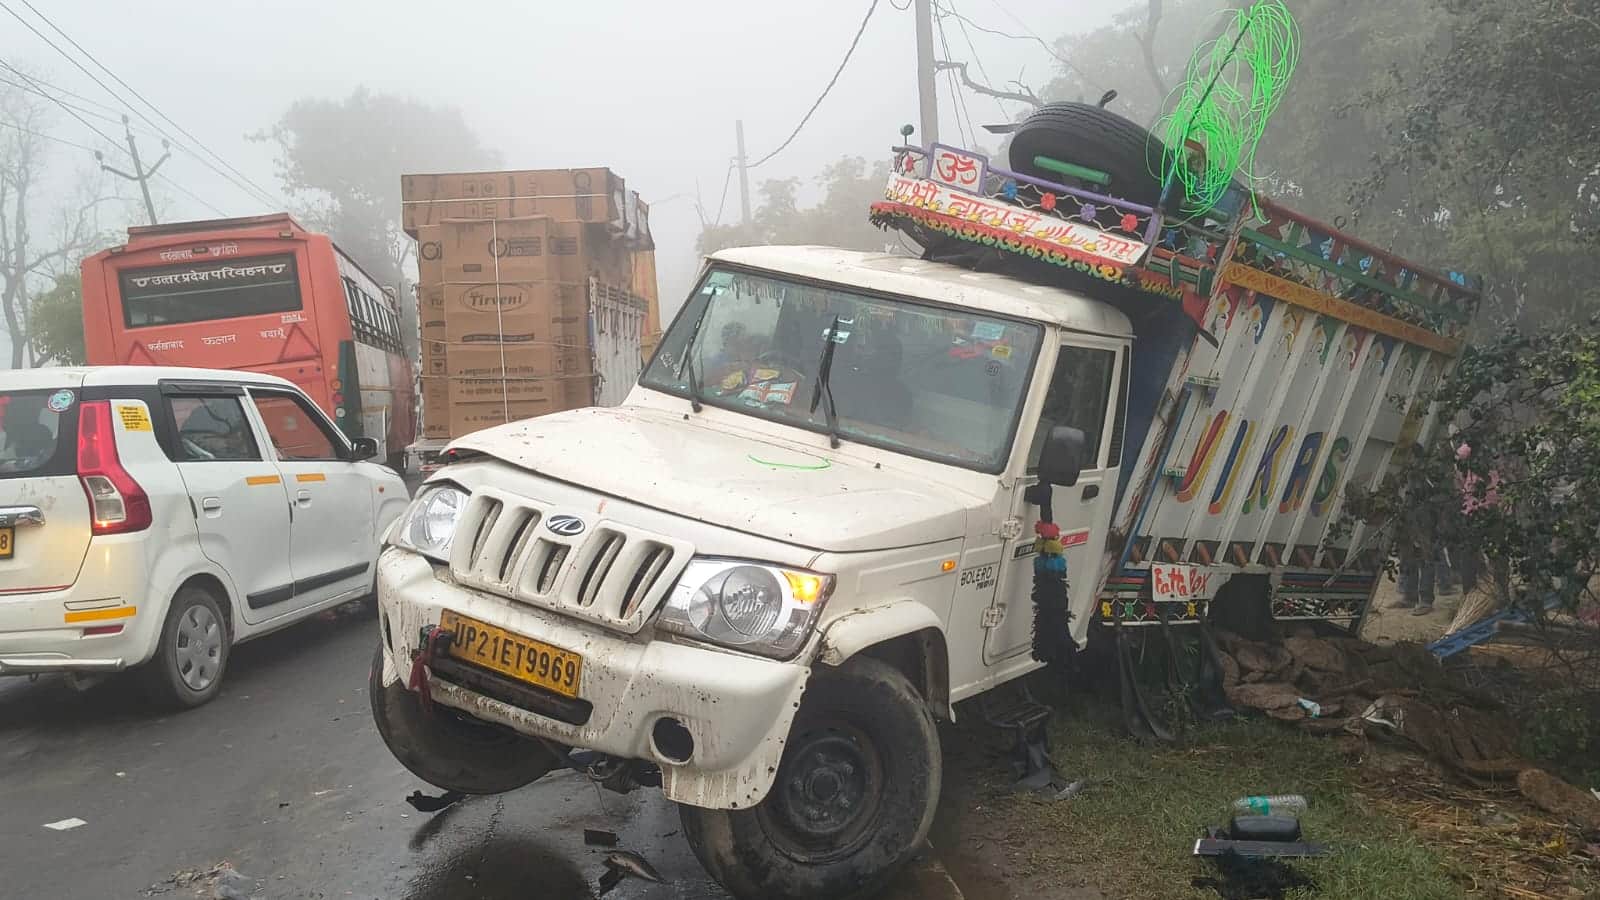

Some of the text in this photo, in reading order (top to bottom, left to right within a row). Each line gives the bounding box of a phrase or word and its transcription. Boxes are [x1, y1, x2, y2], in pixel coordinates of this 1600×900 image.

[151, 264, 267, 286] उत्तर प्रदेश परिवहन
[1177, 409, 1350, 518] VIKAS
[960, 566, 993, 586] BOLERO
[453, 621, 577, 688] UP21ET9969
